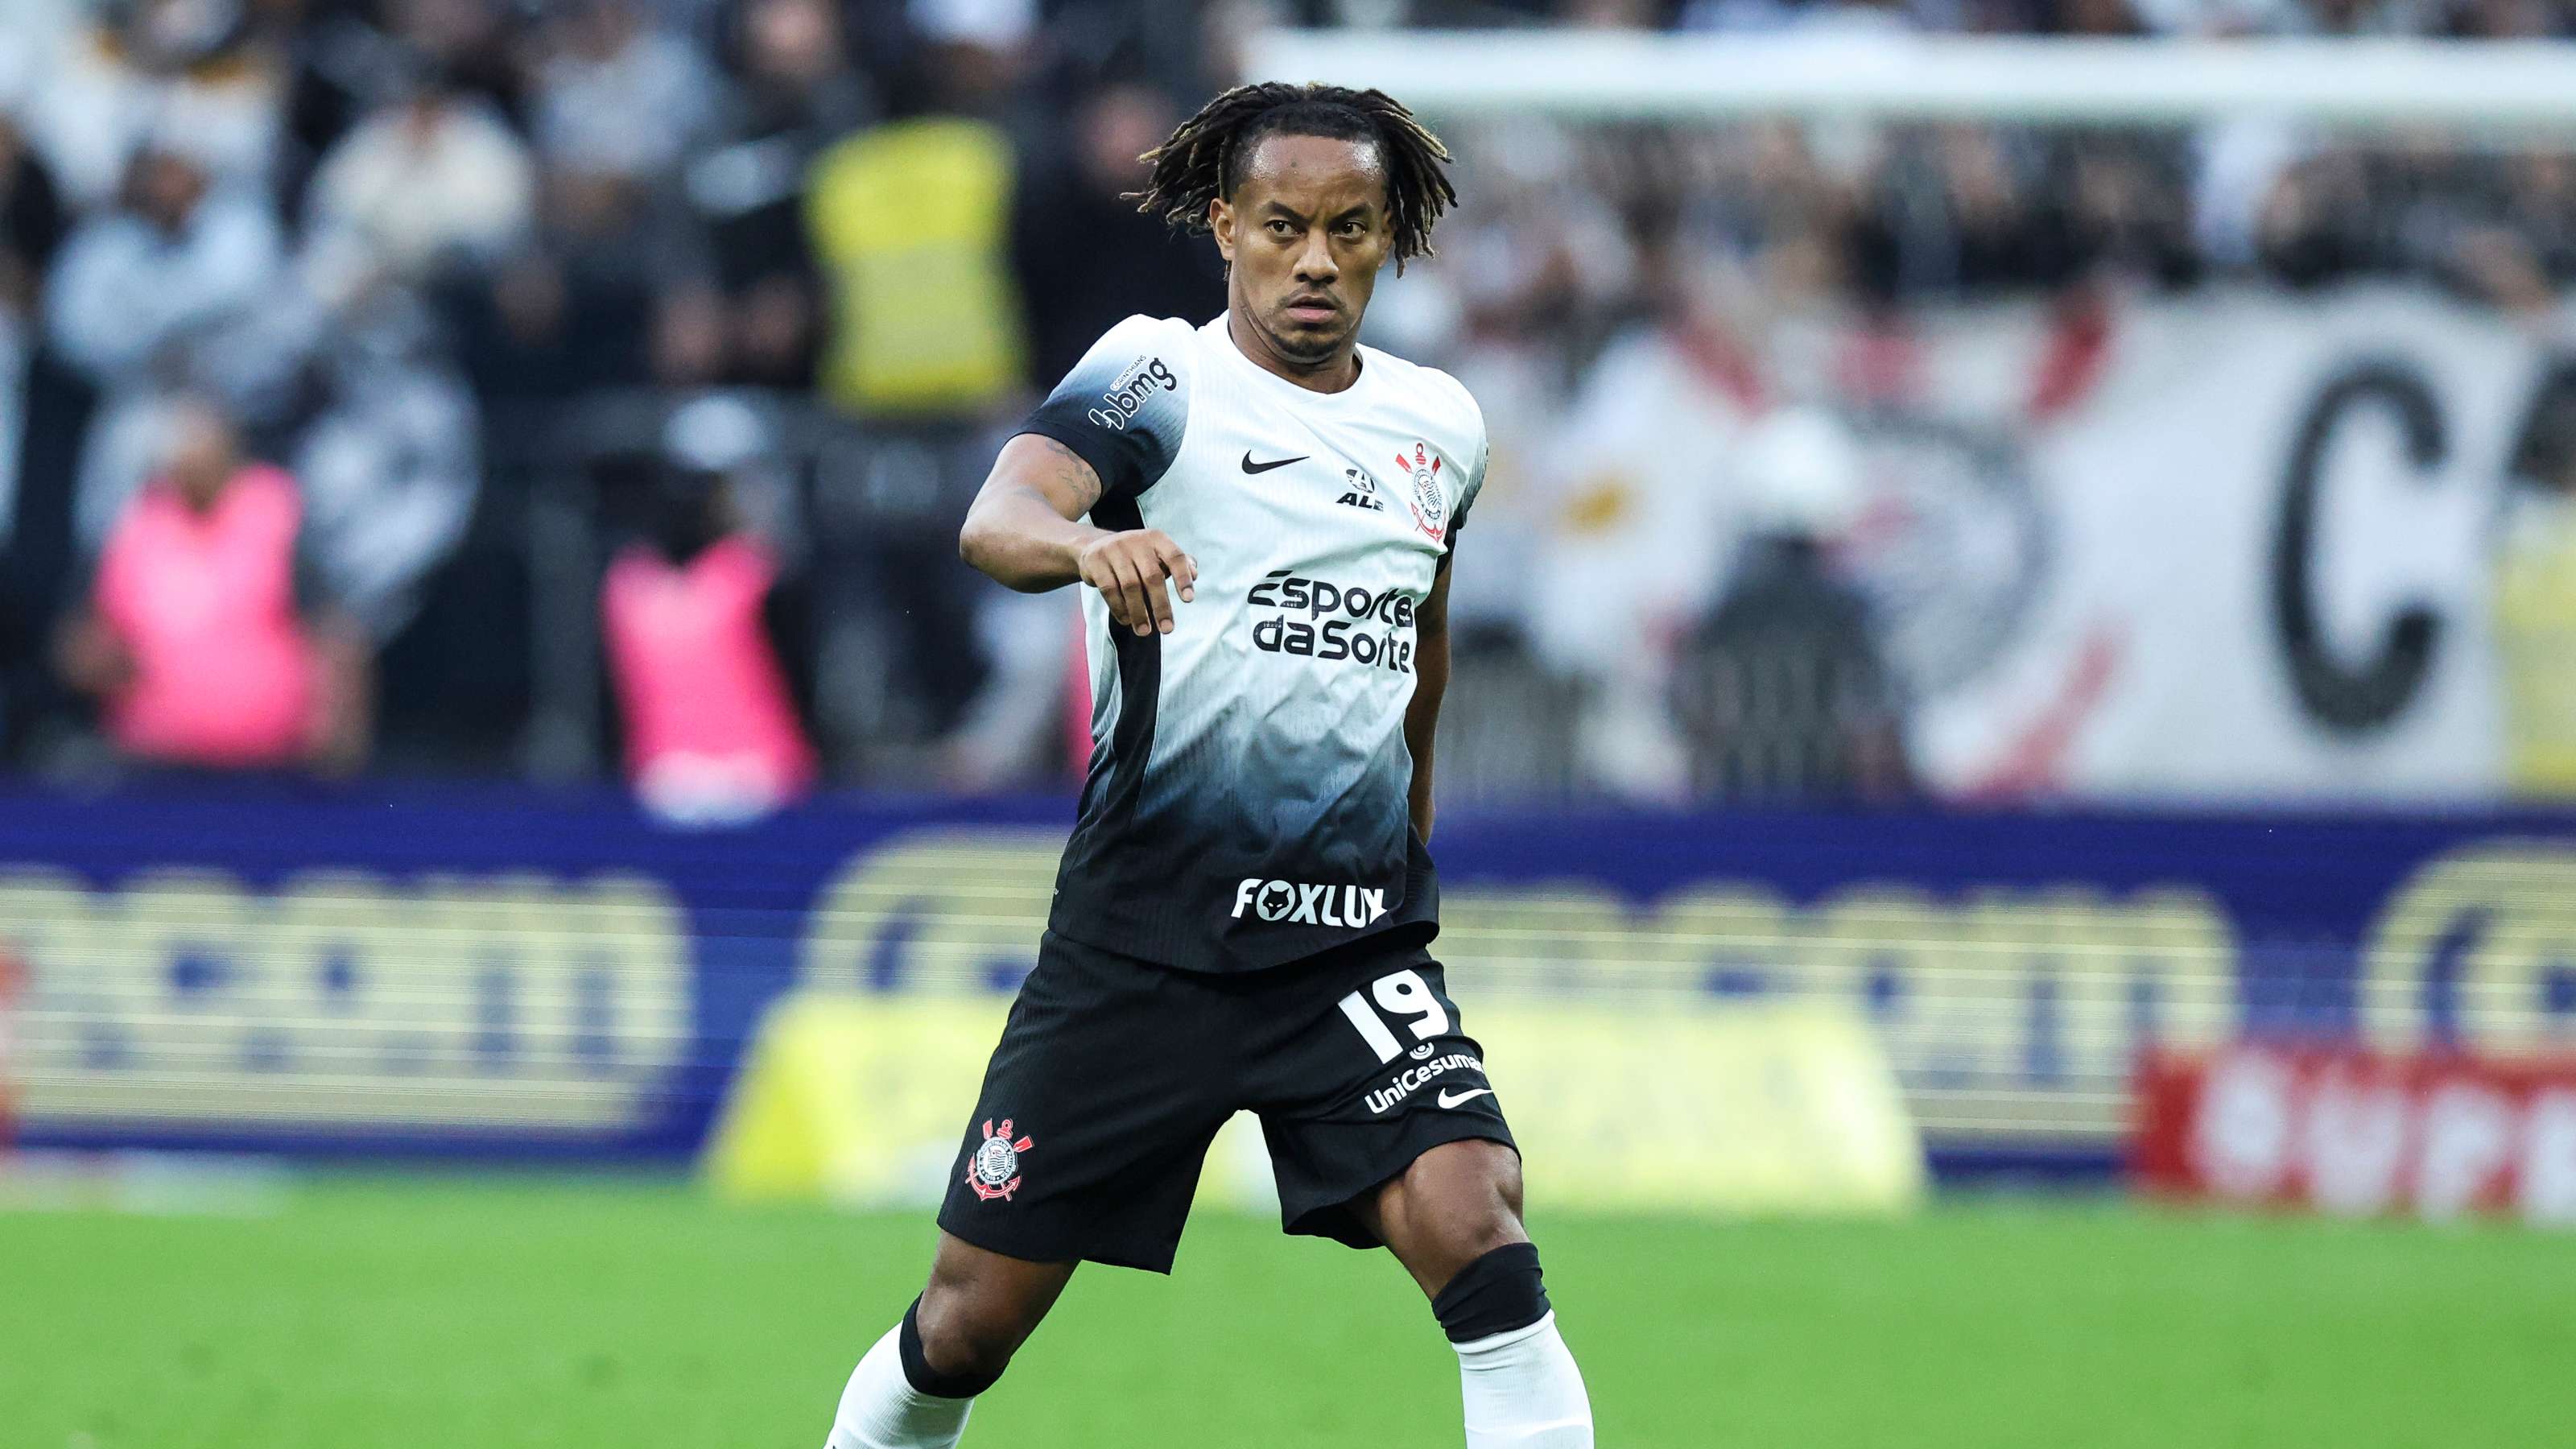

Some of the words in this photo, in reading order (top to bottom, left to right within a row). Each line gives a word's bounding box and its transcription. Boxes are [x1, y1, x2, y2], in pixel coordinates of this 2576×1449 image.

[1111, 355, 1147, 390] CORINTHIANS
[1248, 570, 1414, 627] Esporte
[1338, 968, 1449, 1064] 19
[1364, 1054, 1484, 1114] UniCesuma
